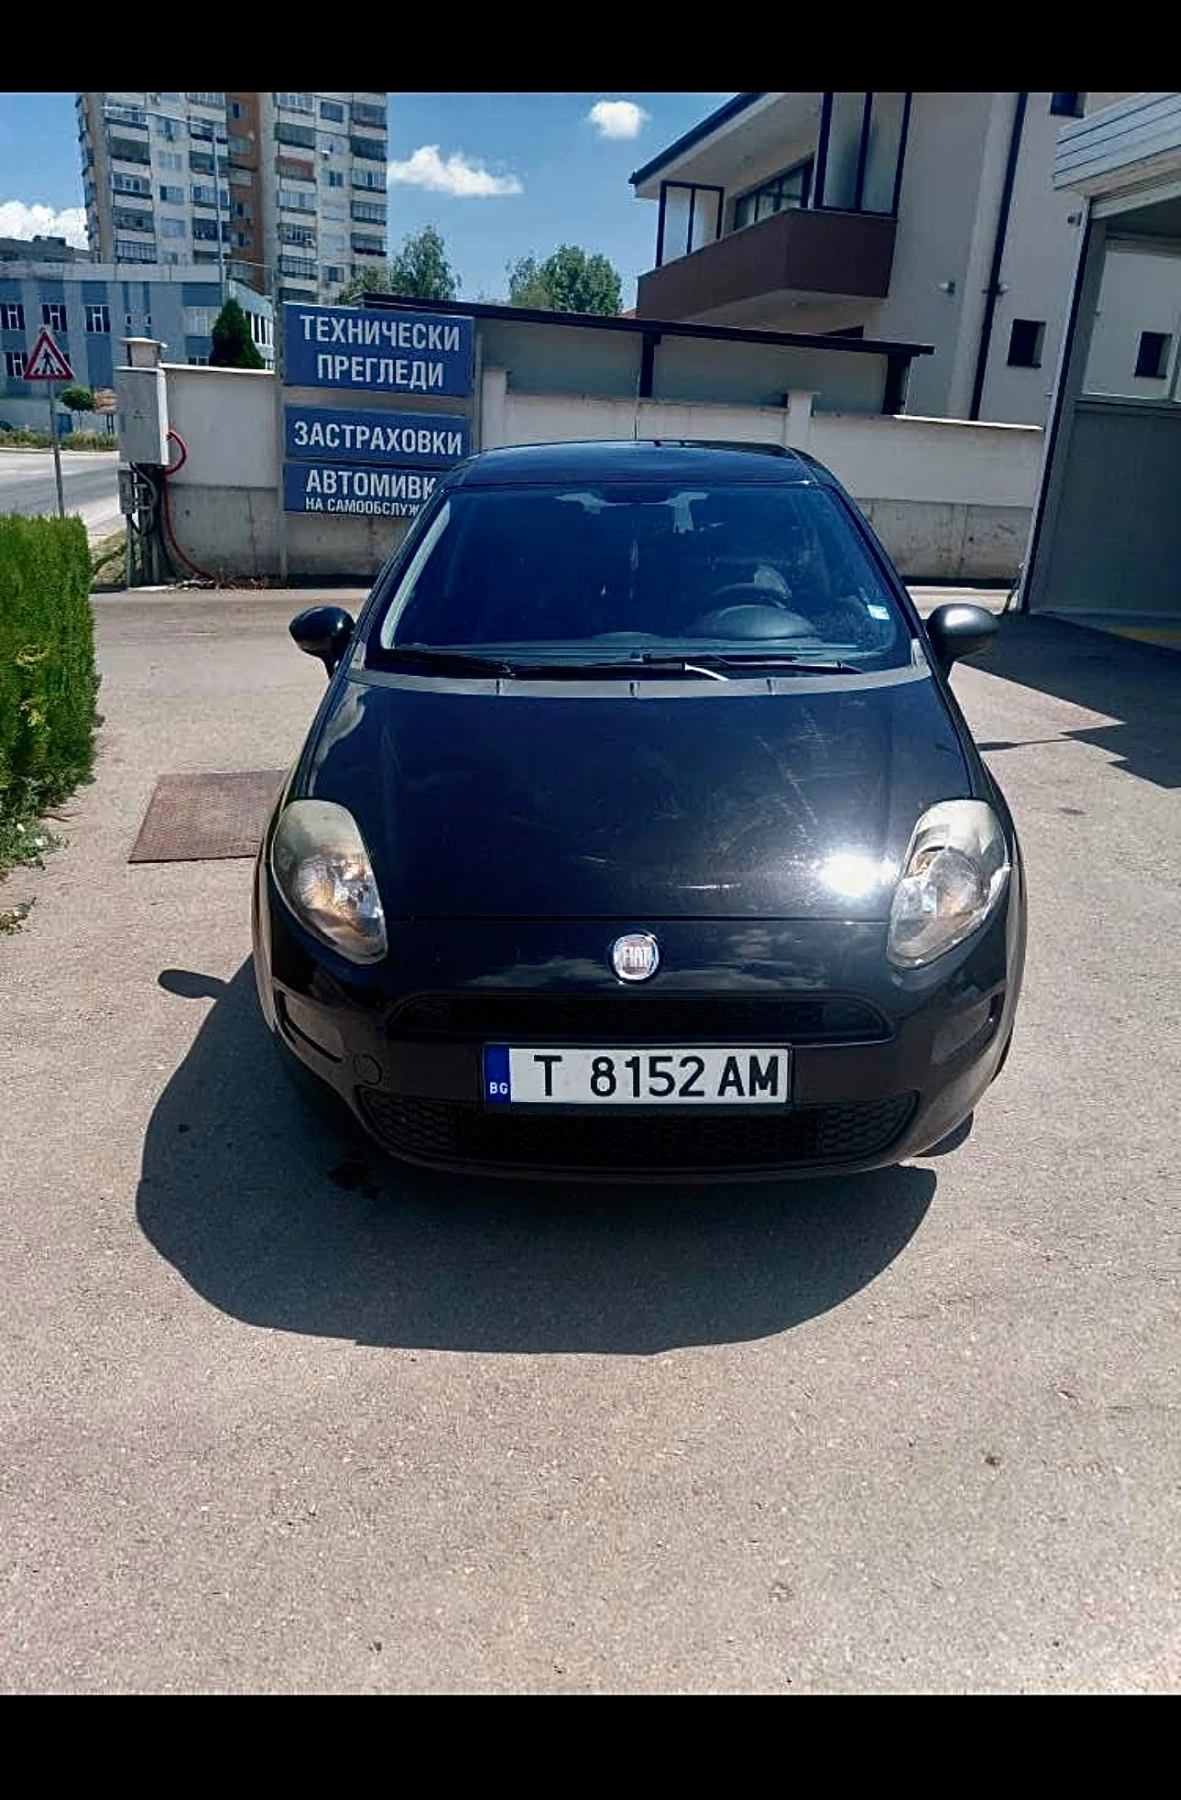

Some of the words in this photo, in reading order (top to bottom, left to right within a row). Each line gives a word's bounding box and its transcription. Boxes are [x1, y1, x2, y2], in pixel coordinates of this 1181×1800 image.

[300, 315, 460, 351] ТЕХНИЧЕСКИ
[317, 354, 443, 390] ПРЕГЛЕДИ
[294, 421, 462, 456] ЗАСТРАХОВКИ
[305, 498, 323, 511] НА
[489, 1081, 508, 1095] BG
[533, 1055, 563, 1097] T
[590, 1056, 705, 1097] 8152
[717, 1056, 779, 1097] AM
